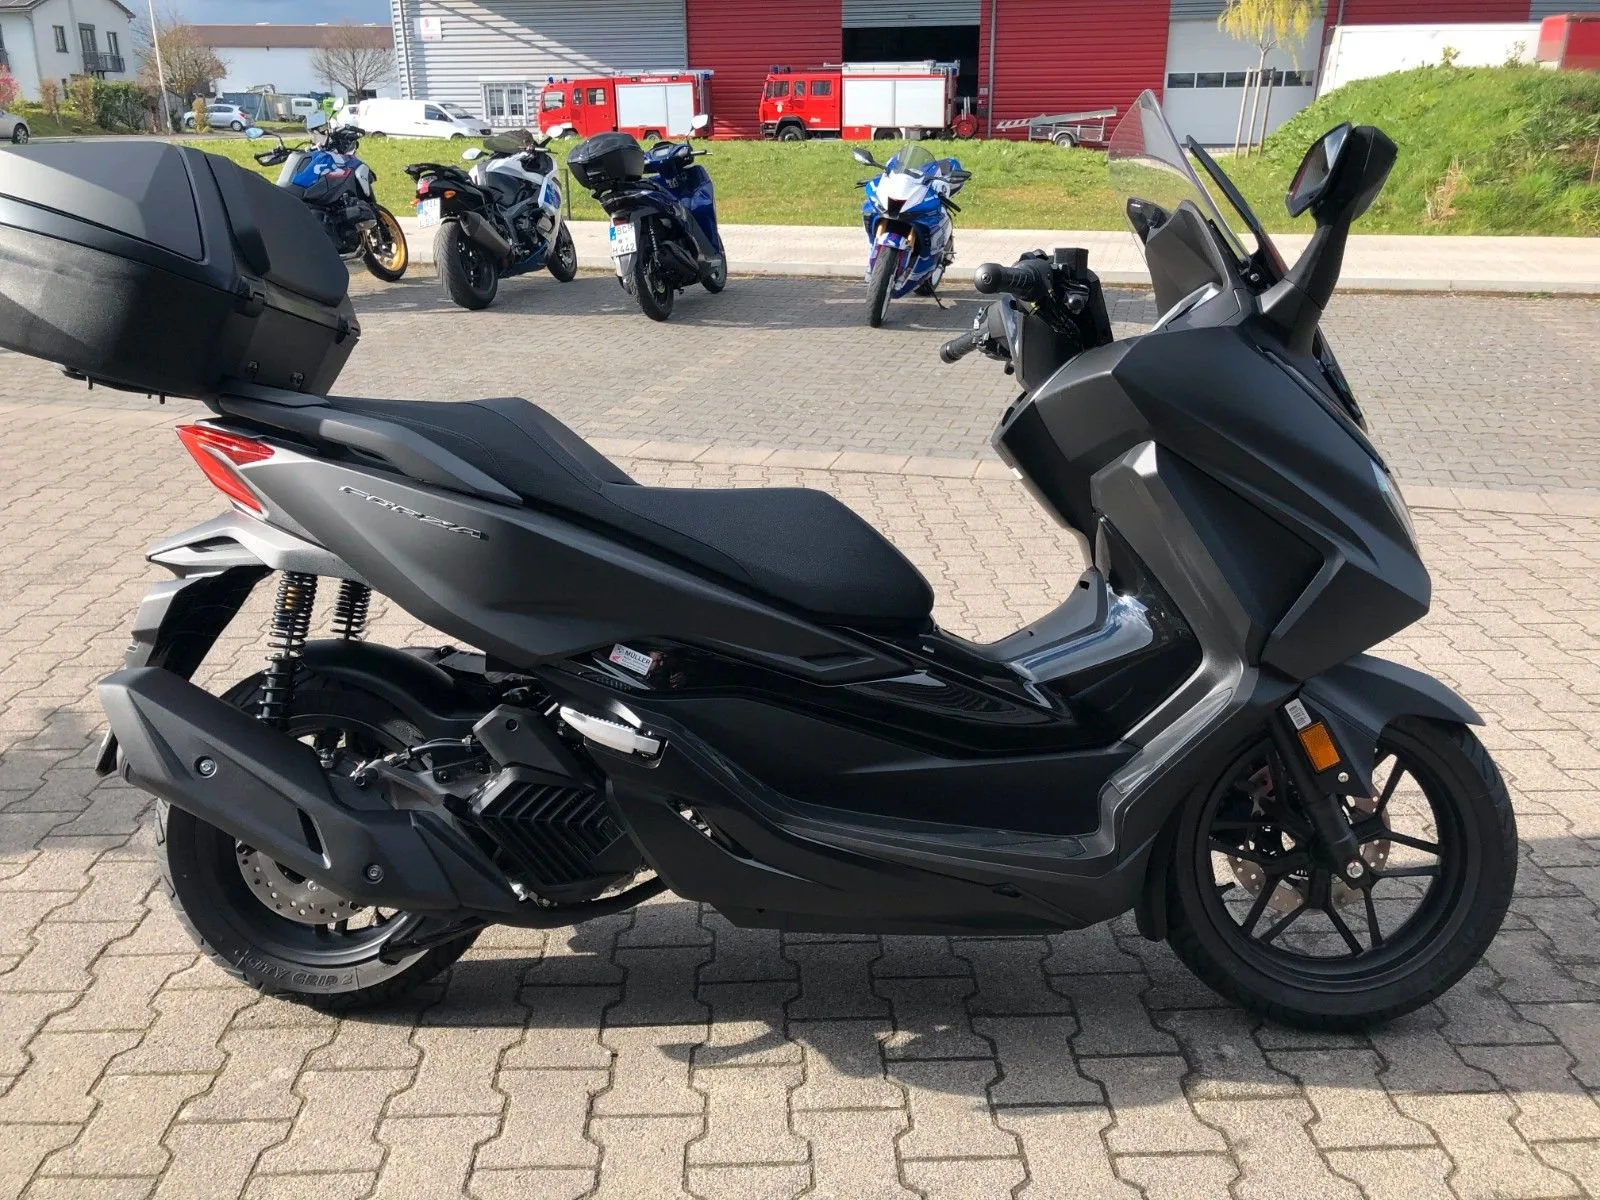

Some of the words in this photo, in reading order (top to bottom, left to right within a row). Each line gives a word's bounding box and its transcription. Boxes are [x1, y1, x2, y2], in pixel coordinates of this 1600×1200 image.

[624, 648, 651, 666] MÜLLER
[292, 972, 339, 986] GRIP
[341, 972, 353, 985] 2
